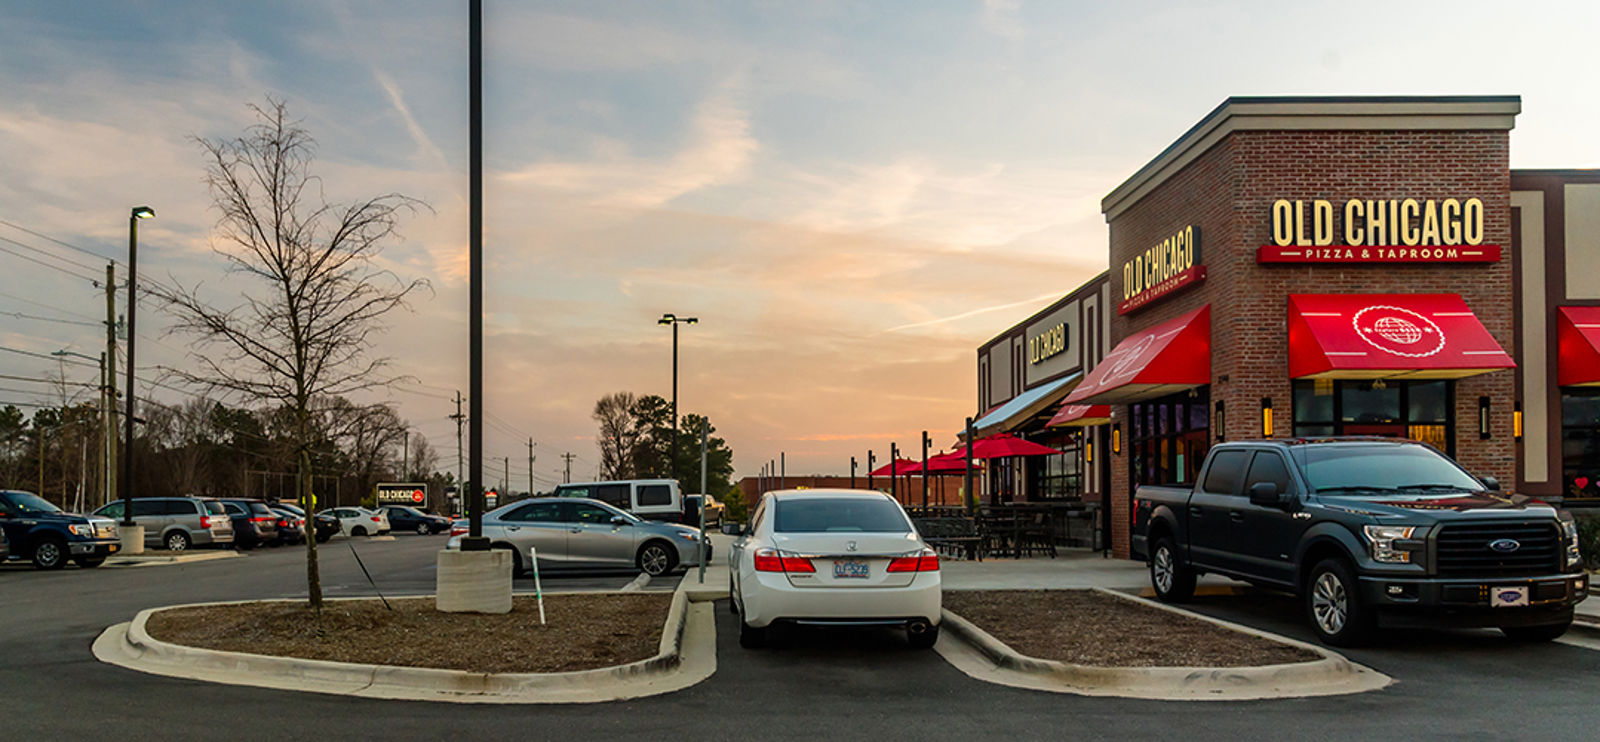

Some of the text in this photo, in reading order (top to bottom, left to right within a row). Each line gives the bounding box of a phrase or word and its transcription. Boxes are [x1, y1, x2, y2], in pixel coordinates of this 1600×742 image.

[1272, 198, 1484, 247] OLD CHICAGO
[1123, 224, 1193, 301] OLD CHICAGO
[1305, 249, 1459, 259] PIZZA & TAPROOM
